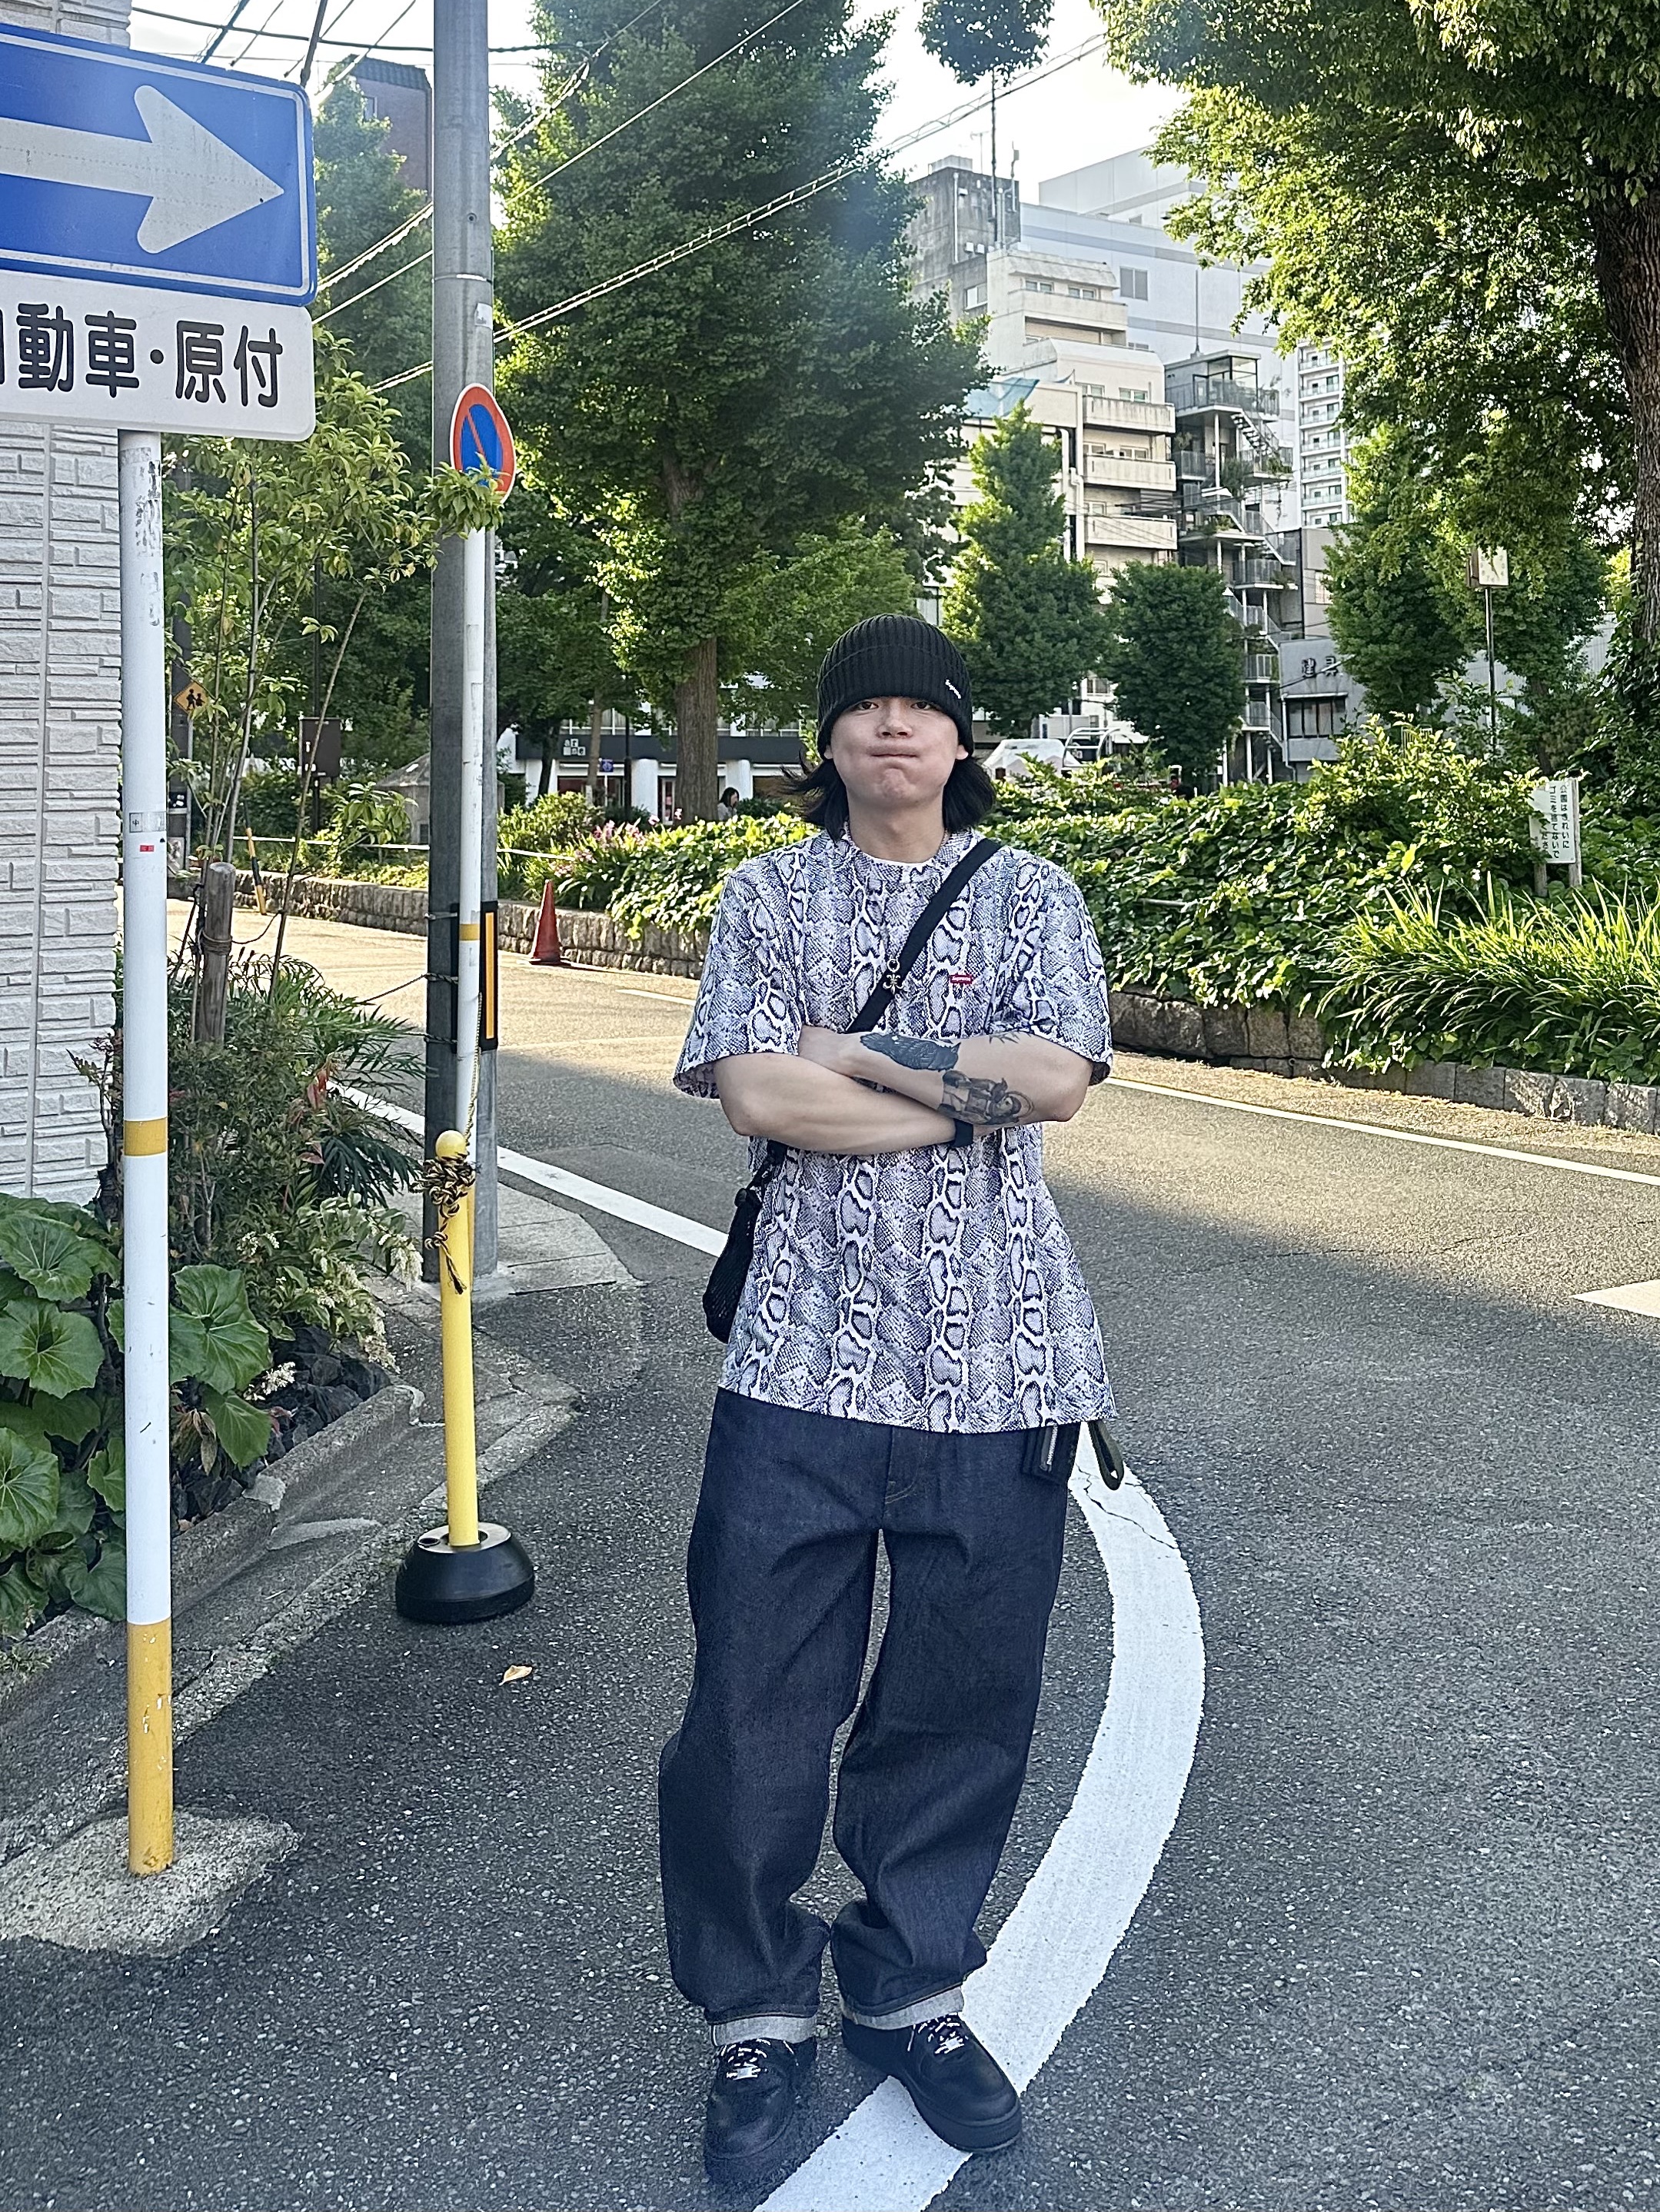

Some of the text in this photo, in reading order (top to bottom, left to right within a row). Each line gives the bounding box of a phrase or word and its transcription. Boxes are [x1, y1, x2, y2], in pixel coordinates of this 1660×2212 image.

[0, 303, 283, 407] 動車・原付
